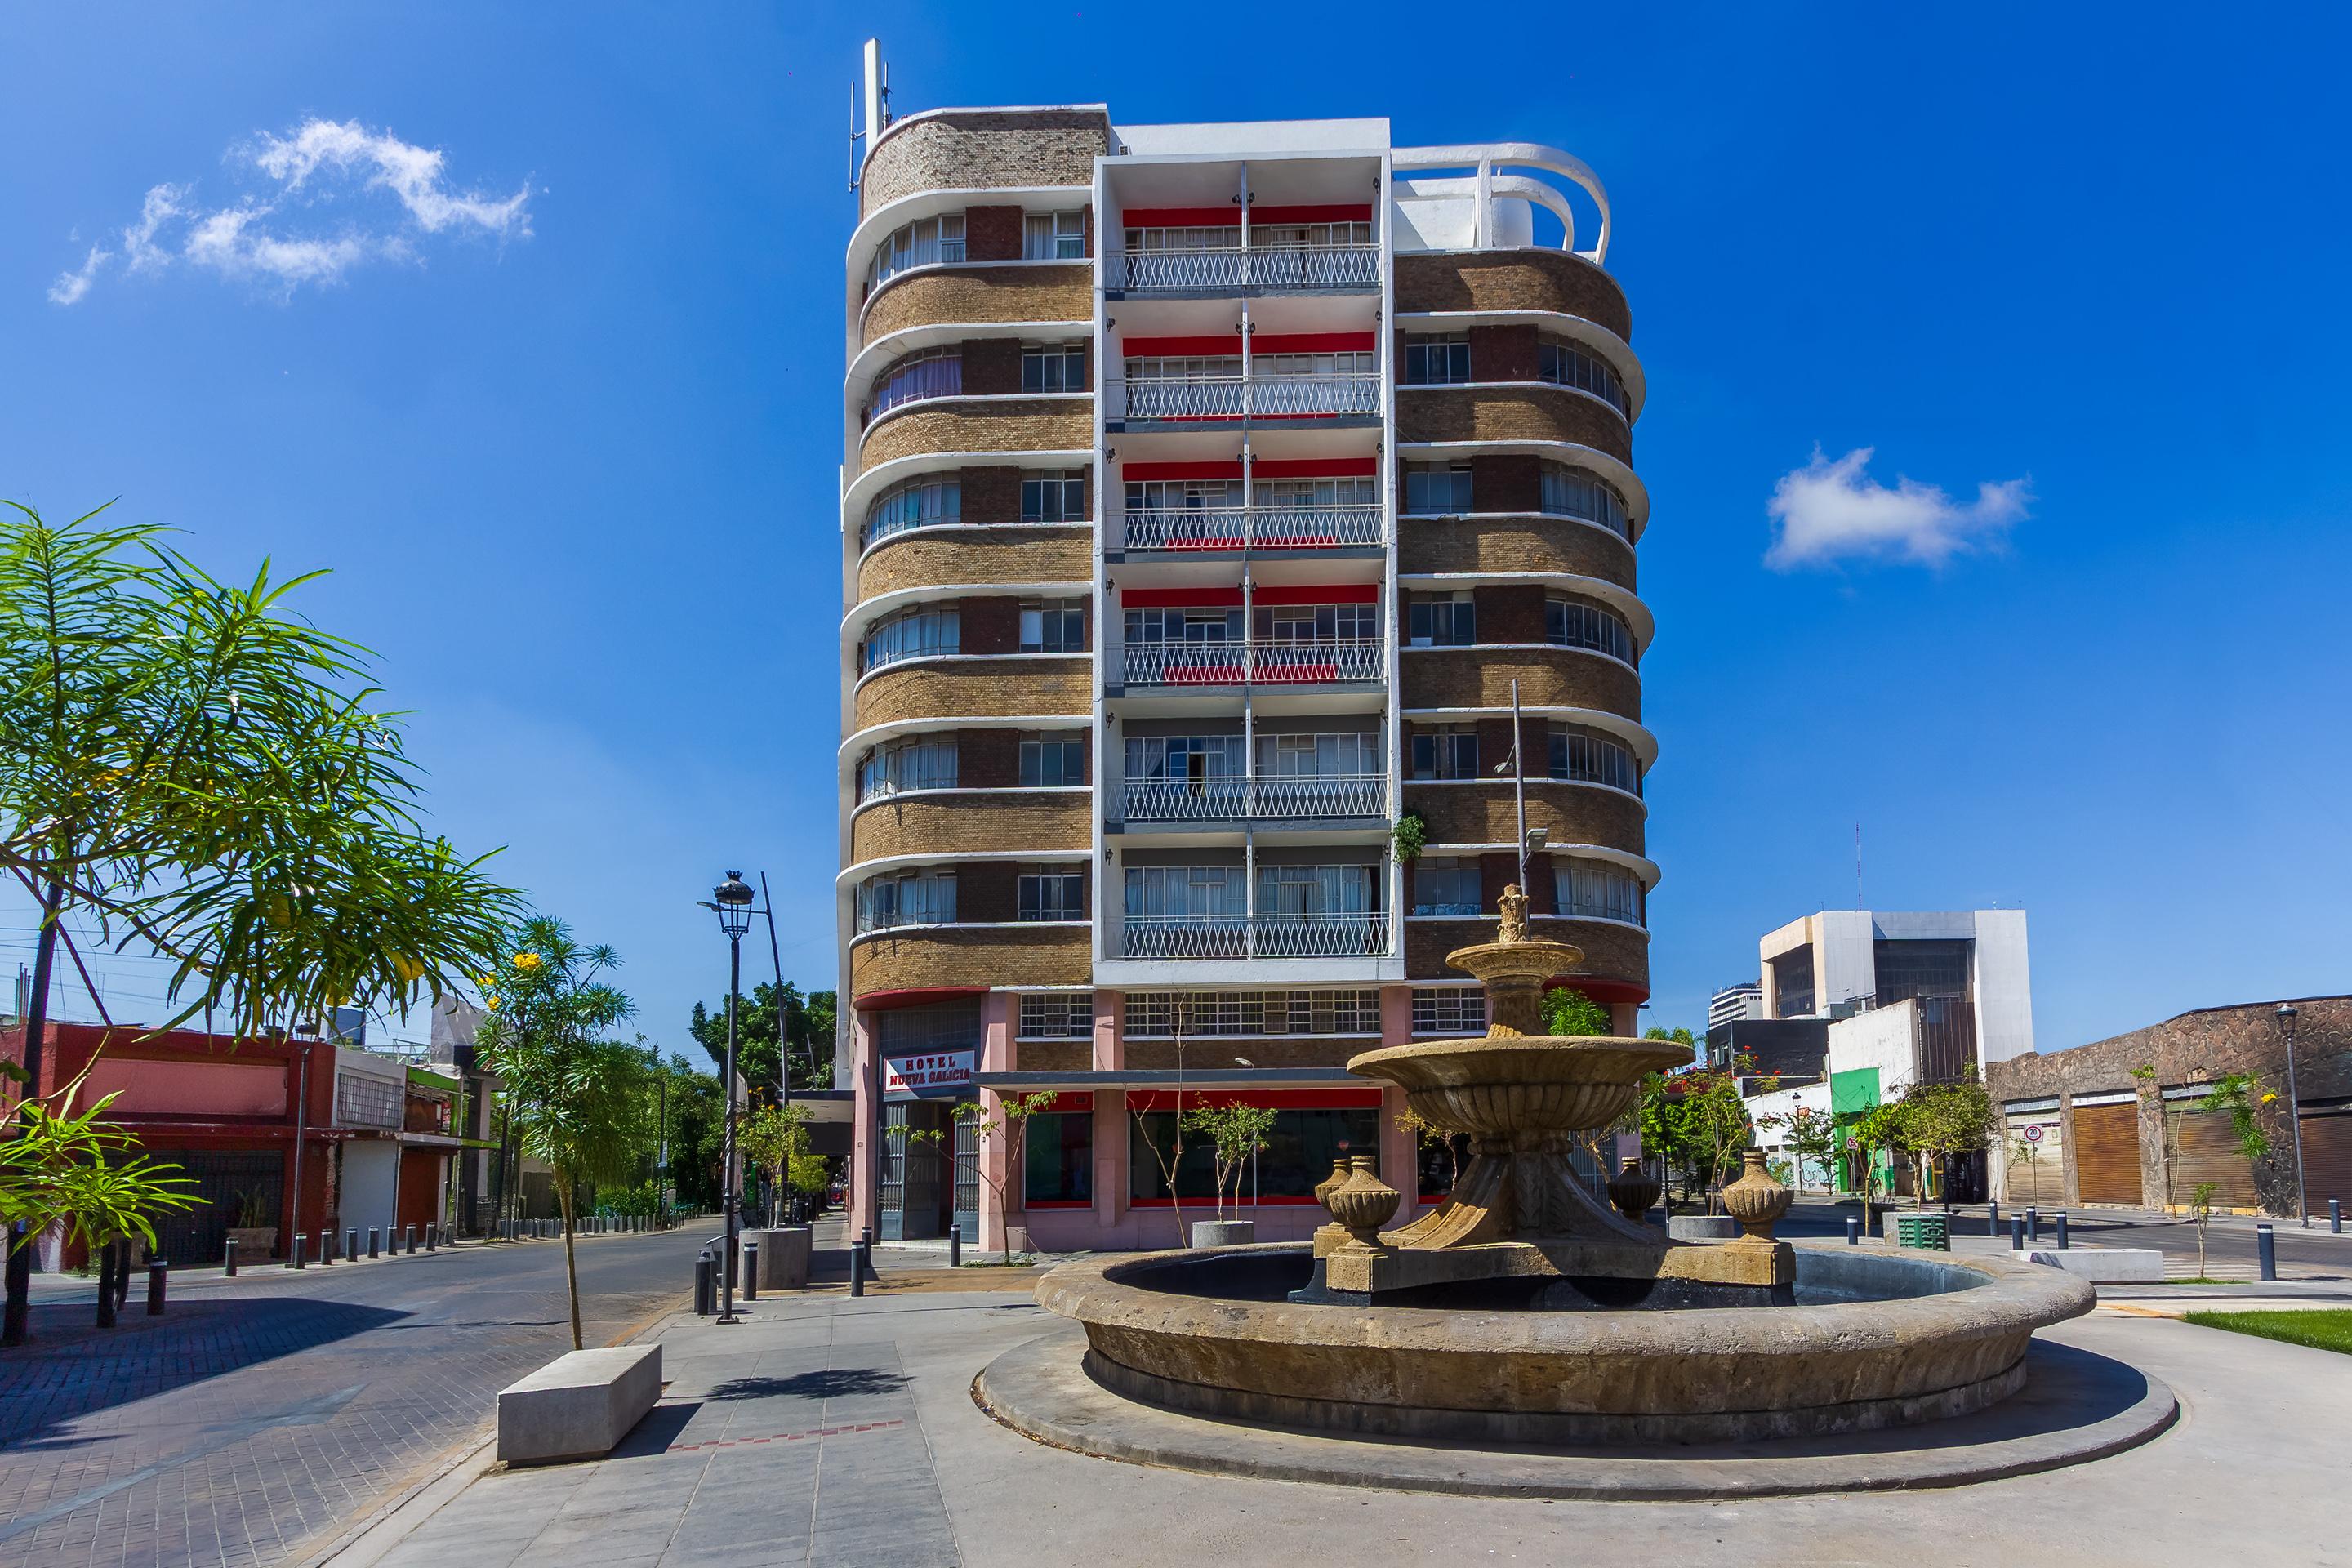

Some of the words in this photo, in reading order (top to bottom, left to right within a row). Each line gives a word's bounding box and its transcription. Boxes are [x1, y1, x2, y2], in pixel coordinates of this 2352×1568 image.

[906, 1056, 956, 1071] HOTEL
[889, 1072, 926, 1086] NUEVA
[928, 1067, 970, 1084] GALICIA
